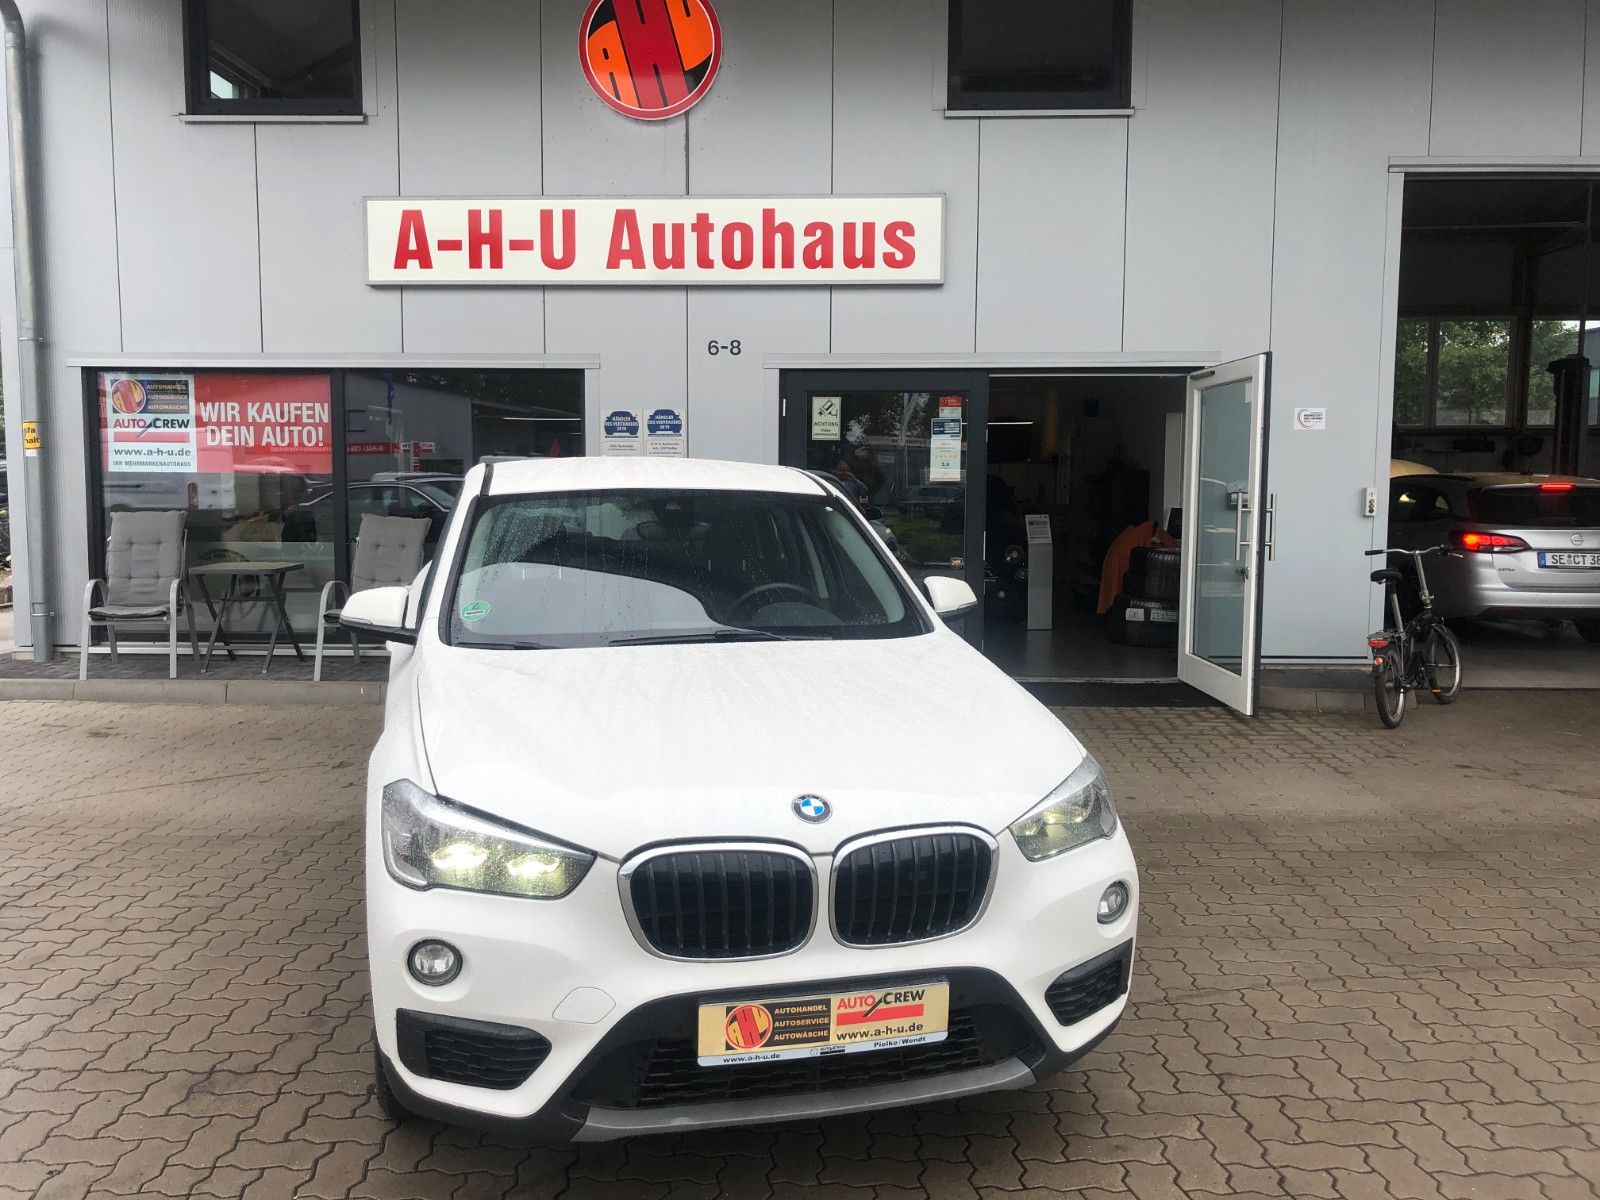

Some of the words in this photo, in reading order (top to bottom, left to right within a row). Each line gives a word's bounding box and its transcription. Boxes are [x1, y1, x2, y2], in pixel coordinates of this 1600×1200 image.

[393, 208, 576, 270] A-H-U
[606, 208, 917, 271] Autohaus
[707, 339, 742, 357] 6-8
[200, 402, 240, 422] WIR
[247, 402, 329, 423] KAUFEN
[206, 426, 255, 446] DEIN
[261, 426, 324, 447] AUTO!
[114, 448, 191, 456] www.a-h-u.de
[1551, 554, 1566, 565] SE
[1573, 554, 1587, 565] CT
[774, 1004, 828, 1015] AUTOHANDEL
[774, 1017, 830, 1028] AUTOSERVICE
[774, 1030, 829, 1041] AUTOWÄSCHE
[836, 1022, 924, 1041] www.a-h-u.de
[723, 1053, 781, 1063] www.a-h-u.de
